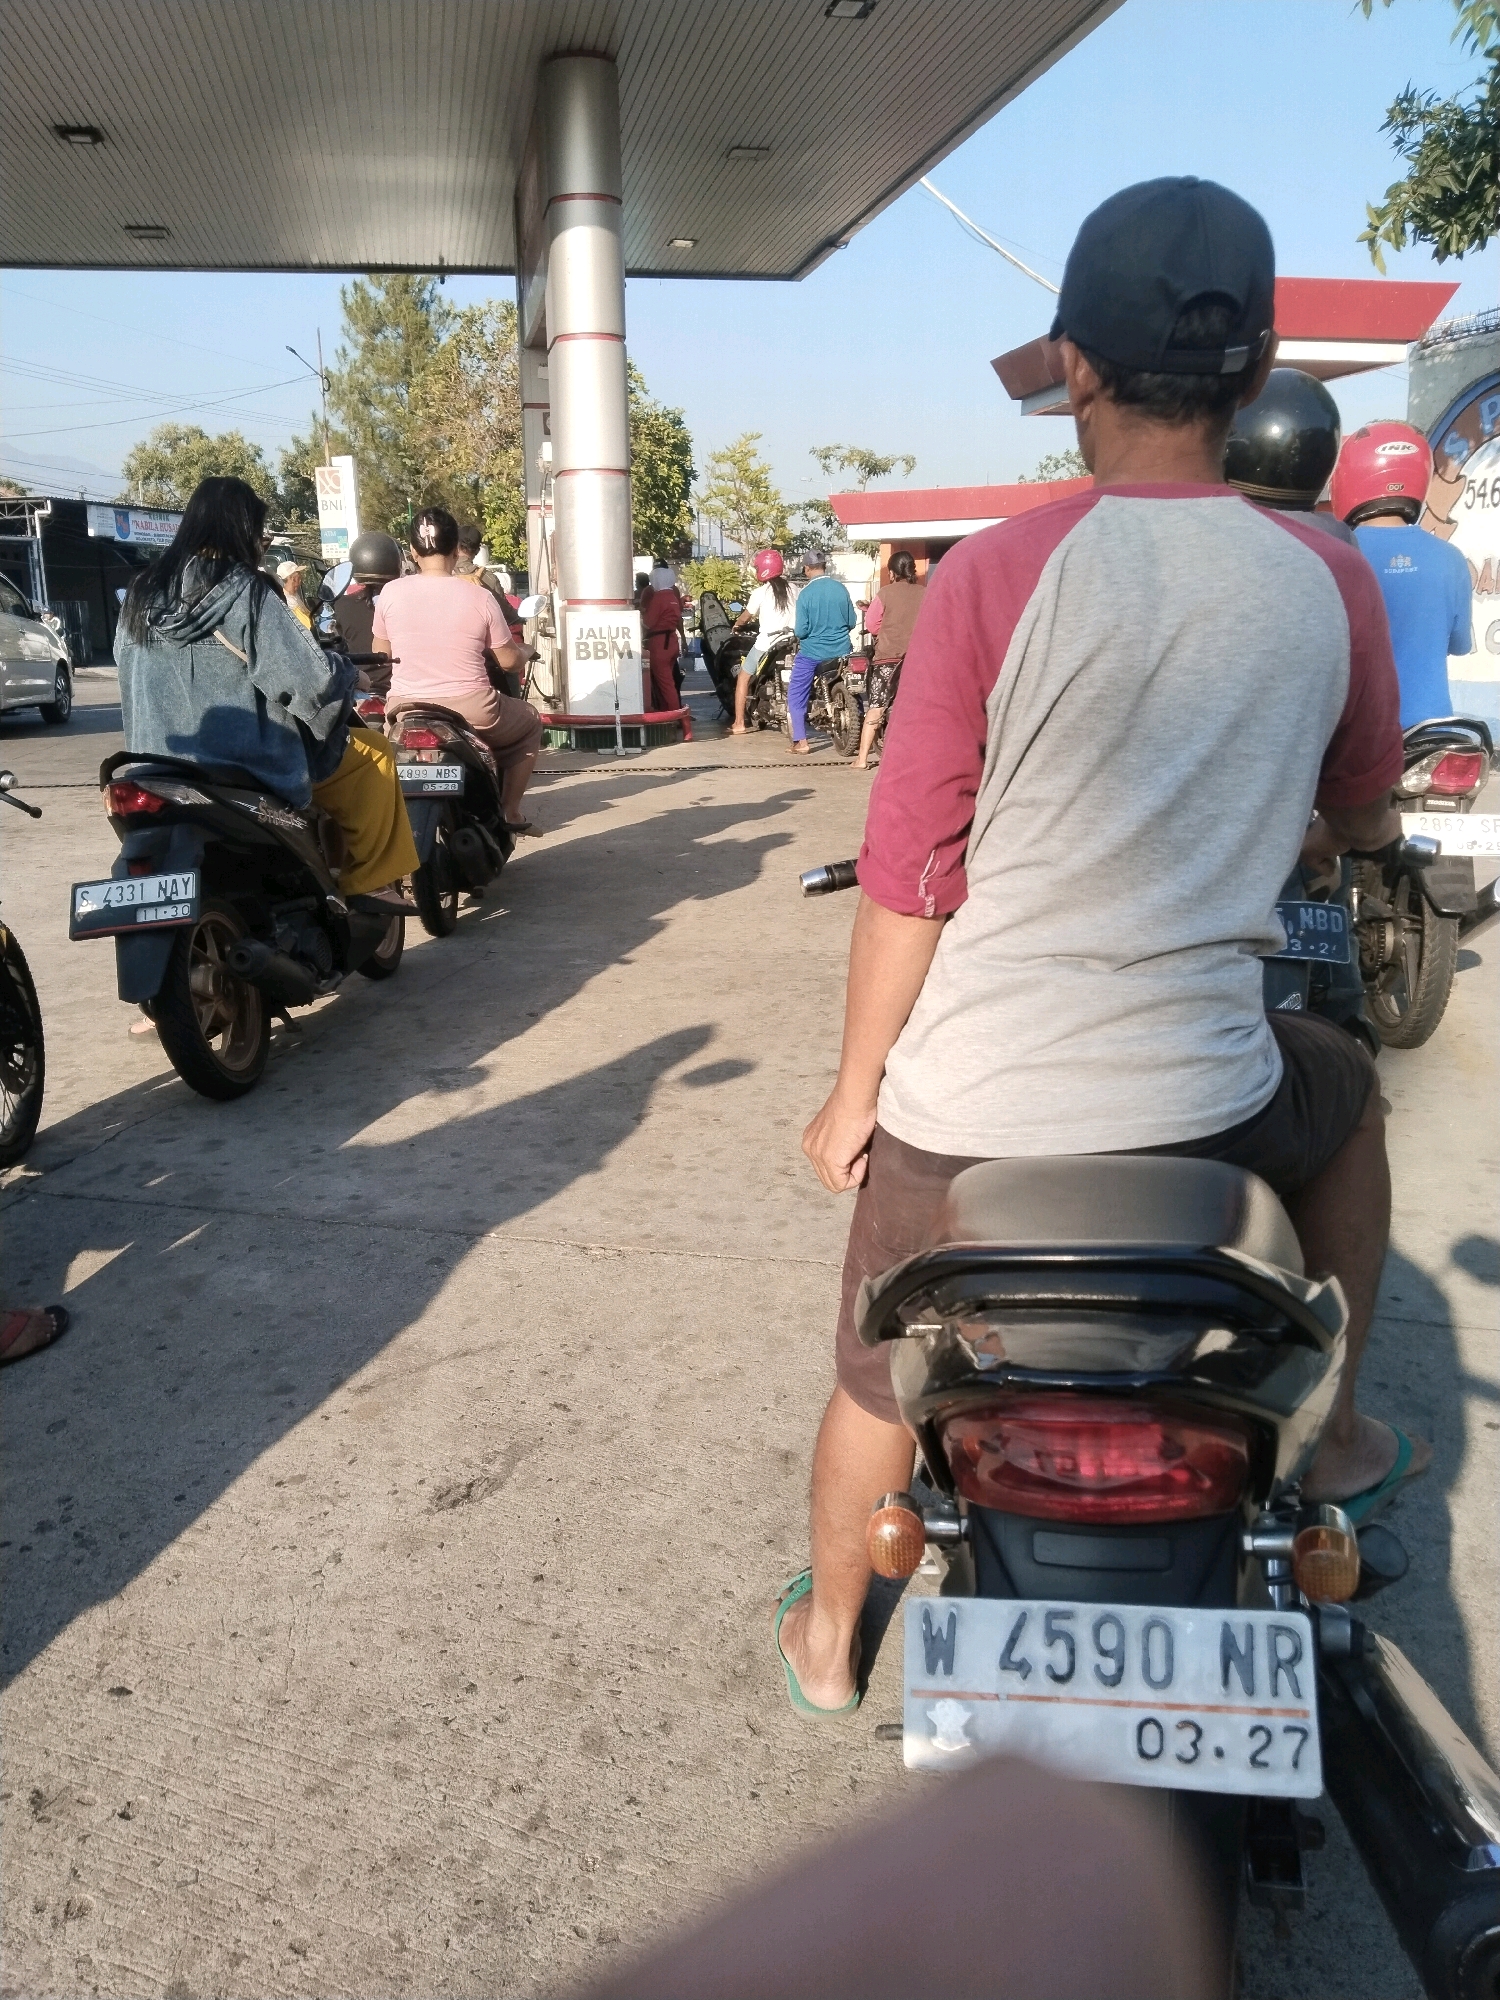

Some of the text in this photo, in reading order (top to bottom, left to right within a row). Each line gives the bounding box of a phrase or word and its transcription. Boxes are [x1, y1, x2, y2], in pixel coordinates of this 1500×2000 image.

[1380, 444, 1413, 452] INK
[321, 499, 343, 511] BNI
[576, 627, 631, 640] JALUR
[575, 641, 633, 660] BBM
[436, 768, 458, 779] NBS
[1426, 799, 1456, 807] HONDA
[80, 877, 191, 907] S 4331 NAY
[1300, 908, 1343, 933] NBD
[922, 1606, 1303, 1699] W 4590 NR
